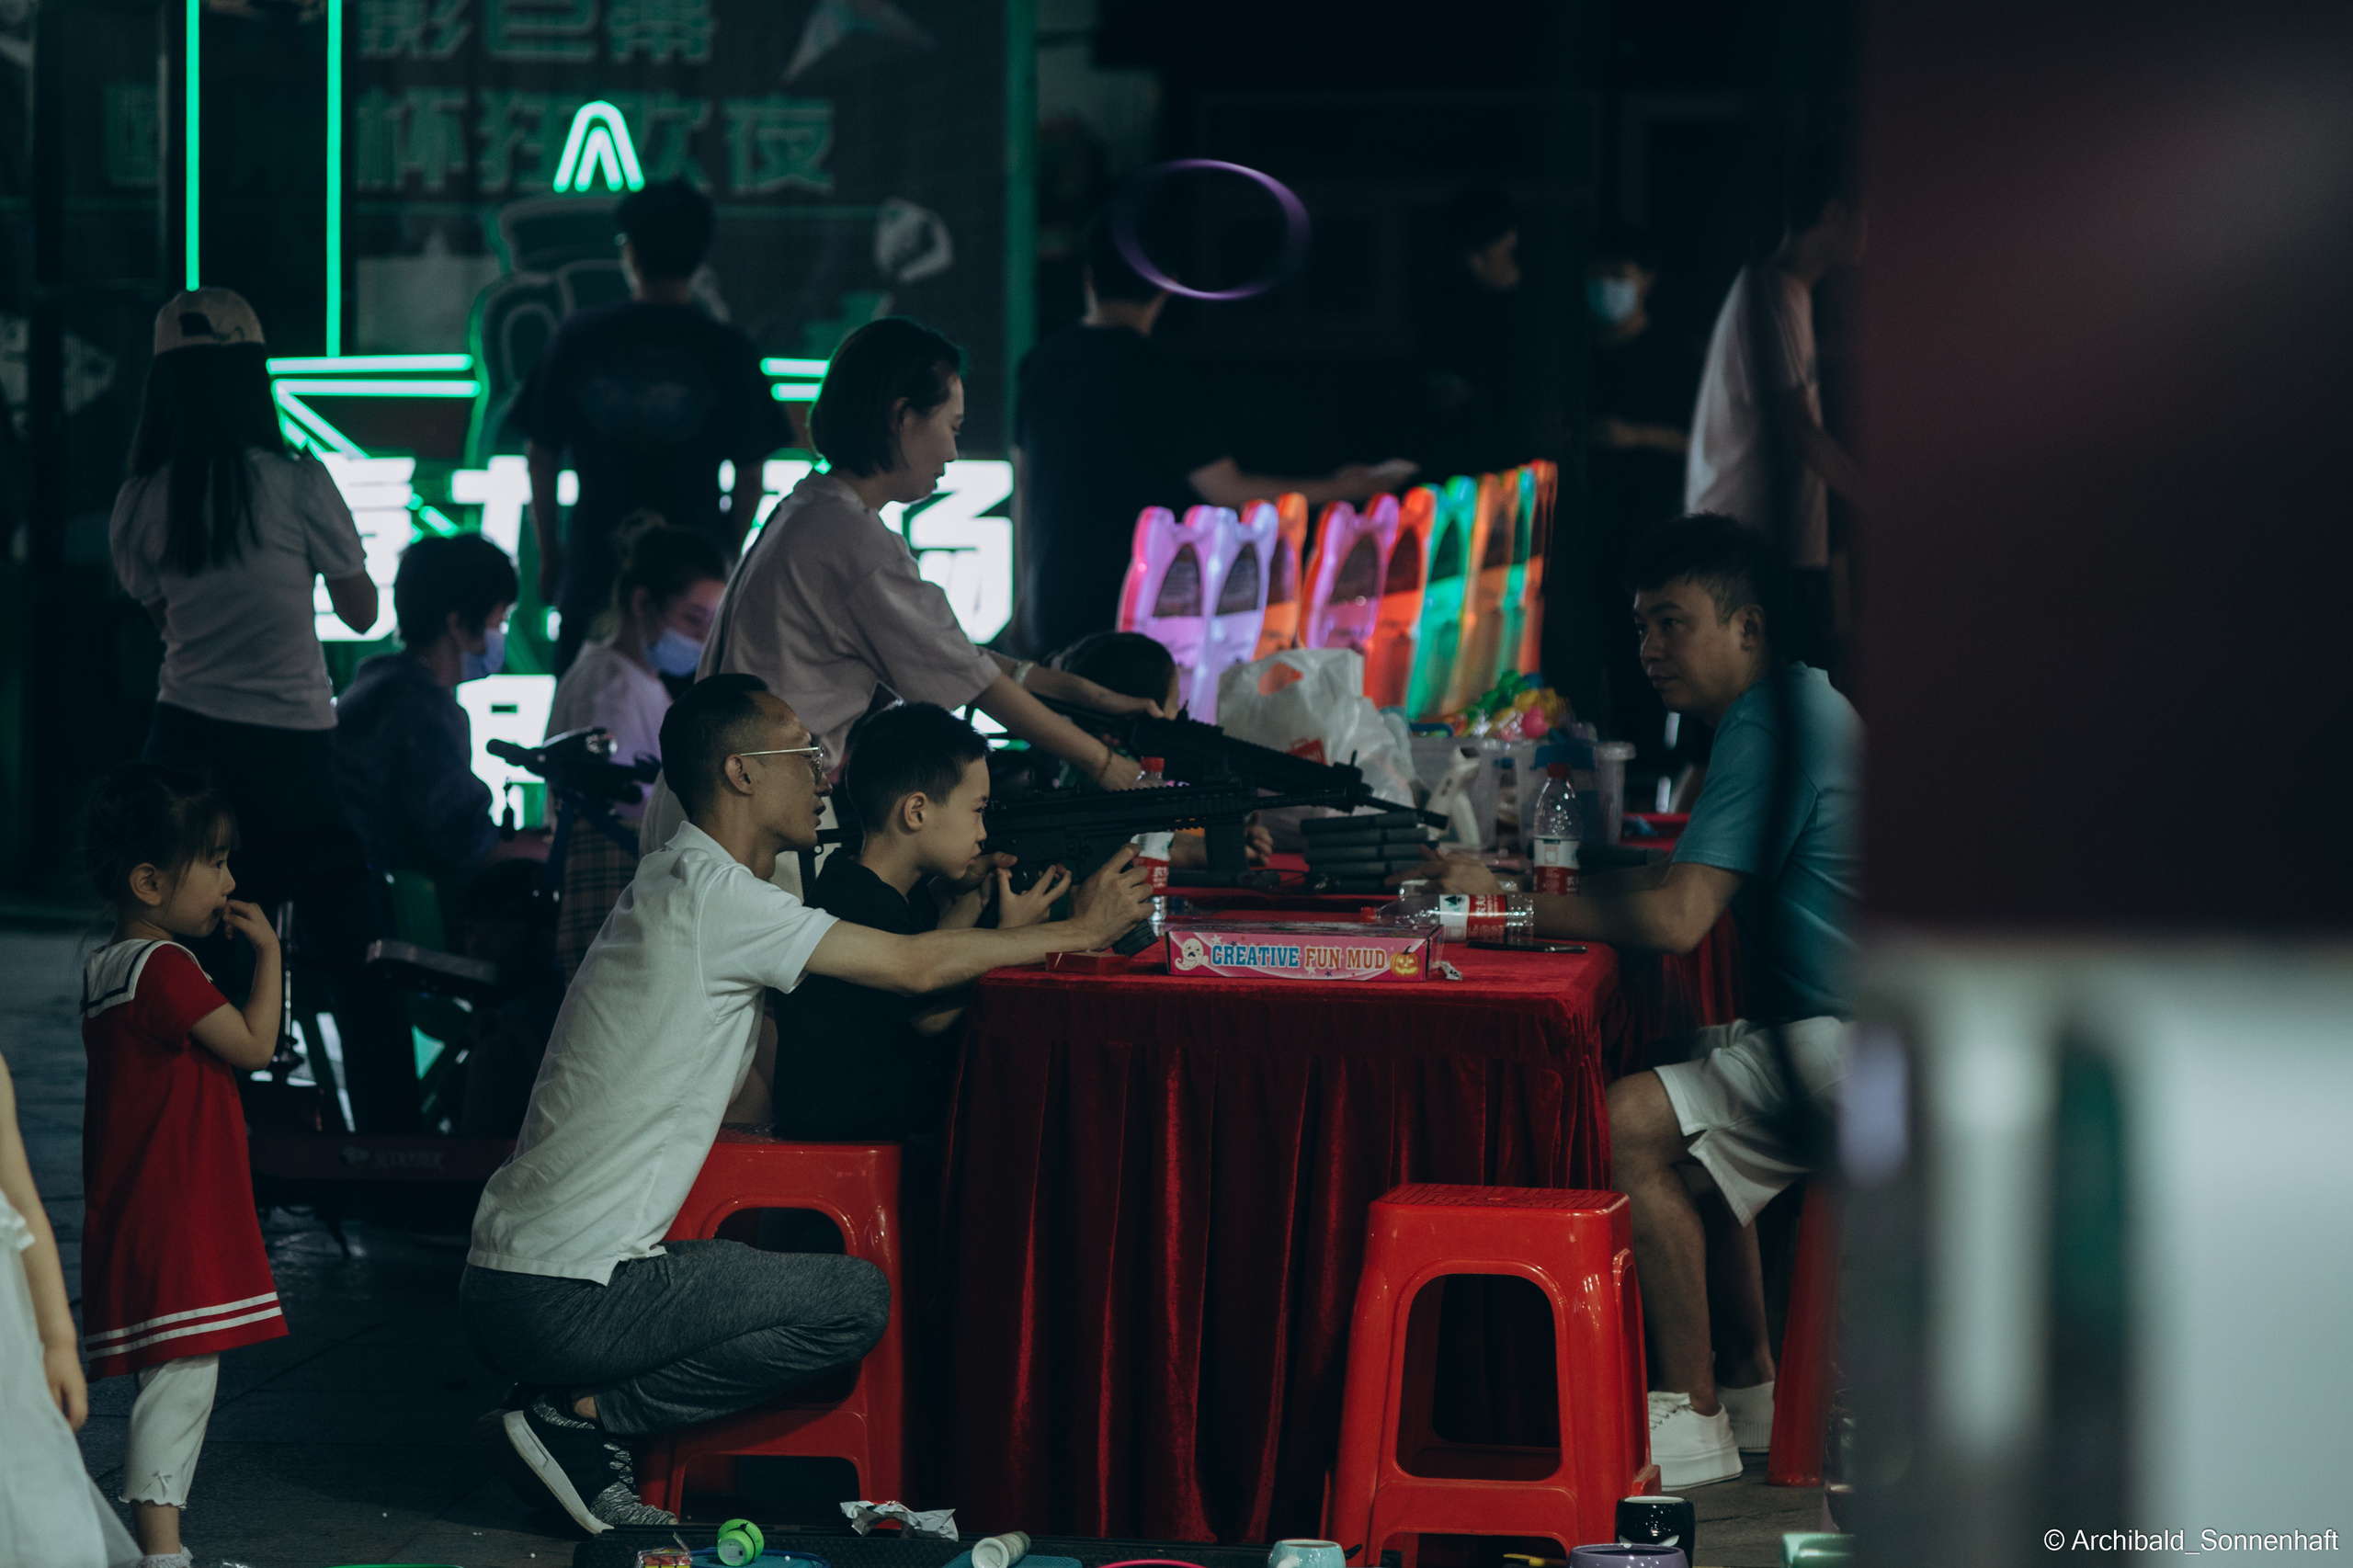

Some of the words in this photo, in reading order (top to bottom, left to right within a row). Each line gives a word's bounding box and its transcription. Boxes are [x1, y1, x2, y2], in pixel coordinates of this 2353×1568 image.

[1211, 944, 1300, 967] CREATIVE
[1304, 947, 1341, 969] FUN
[1346, 948, 1387, 970] MUD
